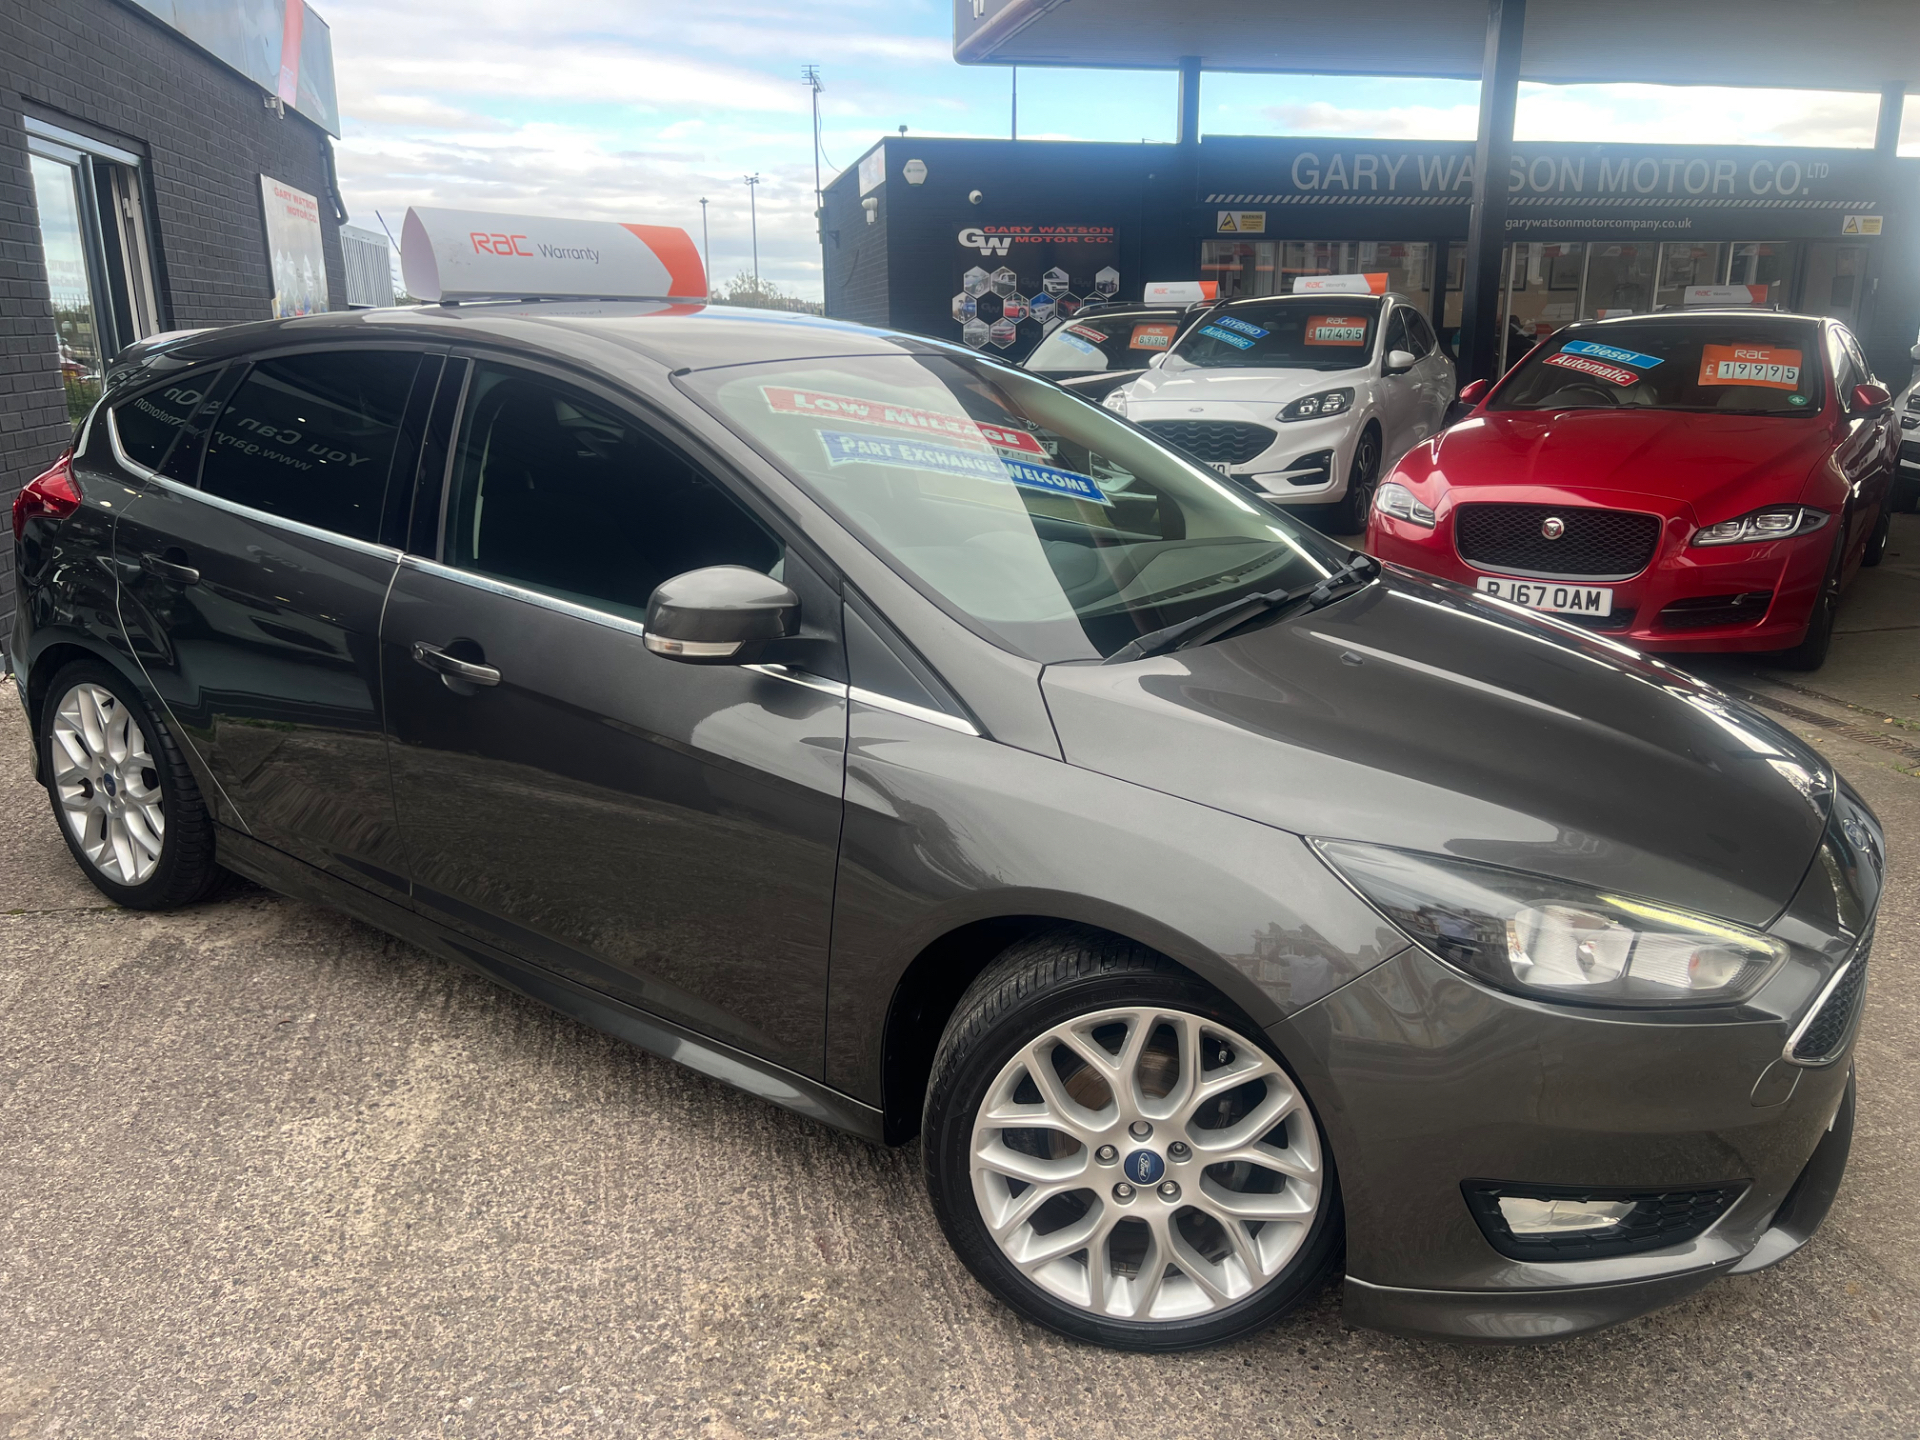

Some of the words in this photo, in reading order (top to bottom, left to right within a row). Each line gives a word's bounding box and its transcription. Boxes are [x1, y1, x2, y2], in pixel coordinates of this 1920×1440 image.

[1291, 152, 1407, 191] GARY
[1417, 154, 1585, 192] WASON
[1597, 157, 1738, 195] MOTOR
[1748, 159, 1809, 195] CO.
[1807, 162, 1829, 179] LTD
[984, 226, 1033, 234] GARY
[1039, 226, 1114, 234] WATSON
[1505, 217, 1691, 231] garywatsonmotorcompany.co.uk
[958, 228, 1012, 256] GW
[1015, 236, 1078, 244] MOTOR
[538, 243, 599, 264] Warranty
[1221, 318, 1261, 334] HYBRID
[1203, 327, 1248, 347] Automatic
[1581, 344, 1639, 361] Diesel
[1551, 355, 1630, 382] Automatic
[794, 394, 869, 416] LOW
[885, 409, 1020, 445] MILEAGE
[840, 436, 891, 458] PART
[898, 444, 999, 473] EXCHANGE
[1001, 463, 1090, 493] WELCOME
[1553, 588, 1601, 611] OAM
